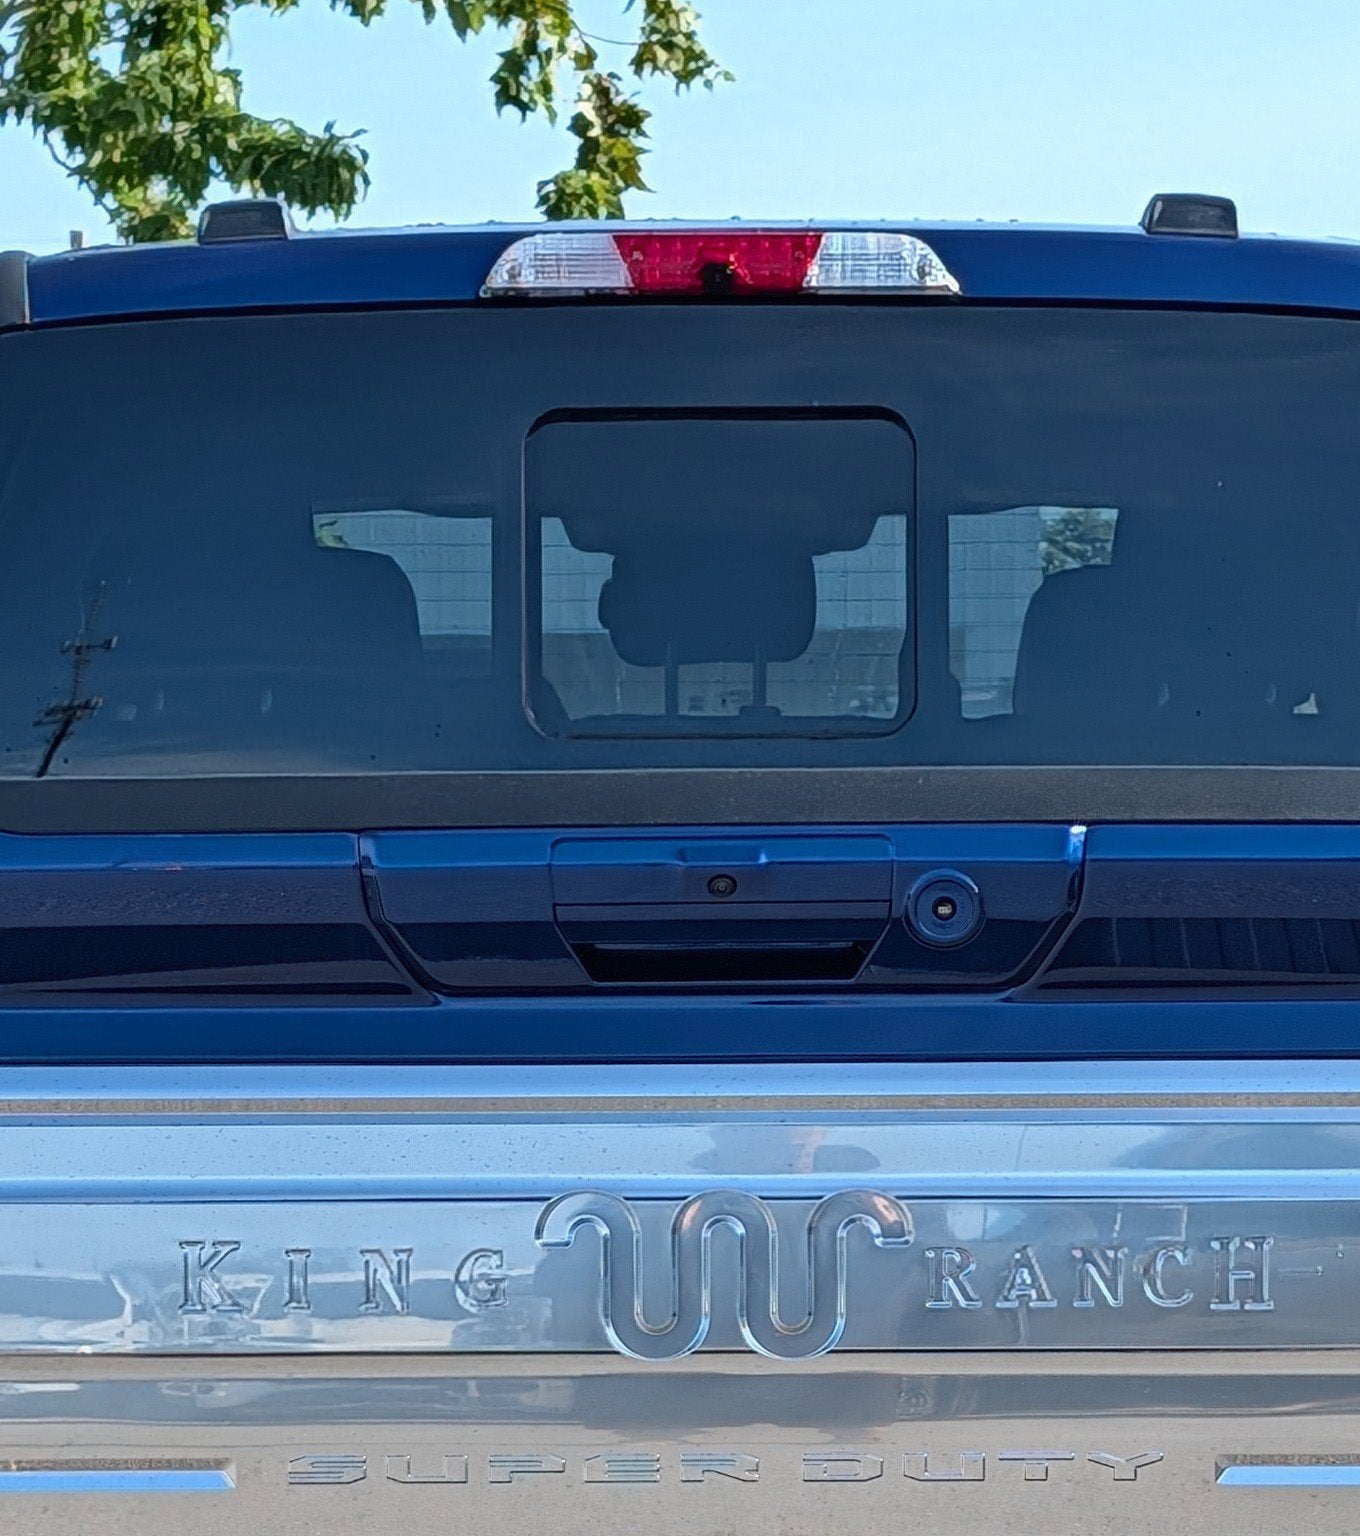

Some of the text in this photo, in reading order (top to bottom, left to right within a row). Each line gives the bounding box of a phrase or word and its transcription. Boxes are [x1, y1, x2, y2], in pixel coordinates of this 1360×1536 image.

[177, 1235, 1276, 1313] KING RANCH
[287, 1450, 1164, 1484] SUPER DUTY
